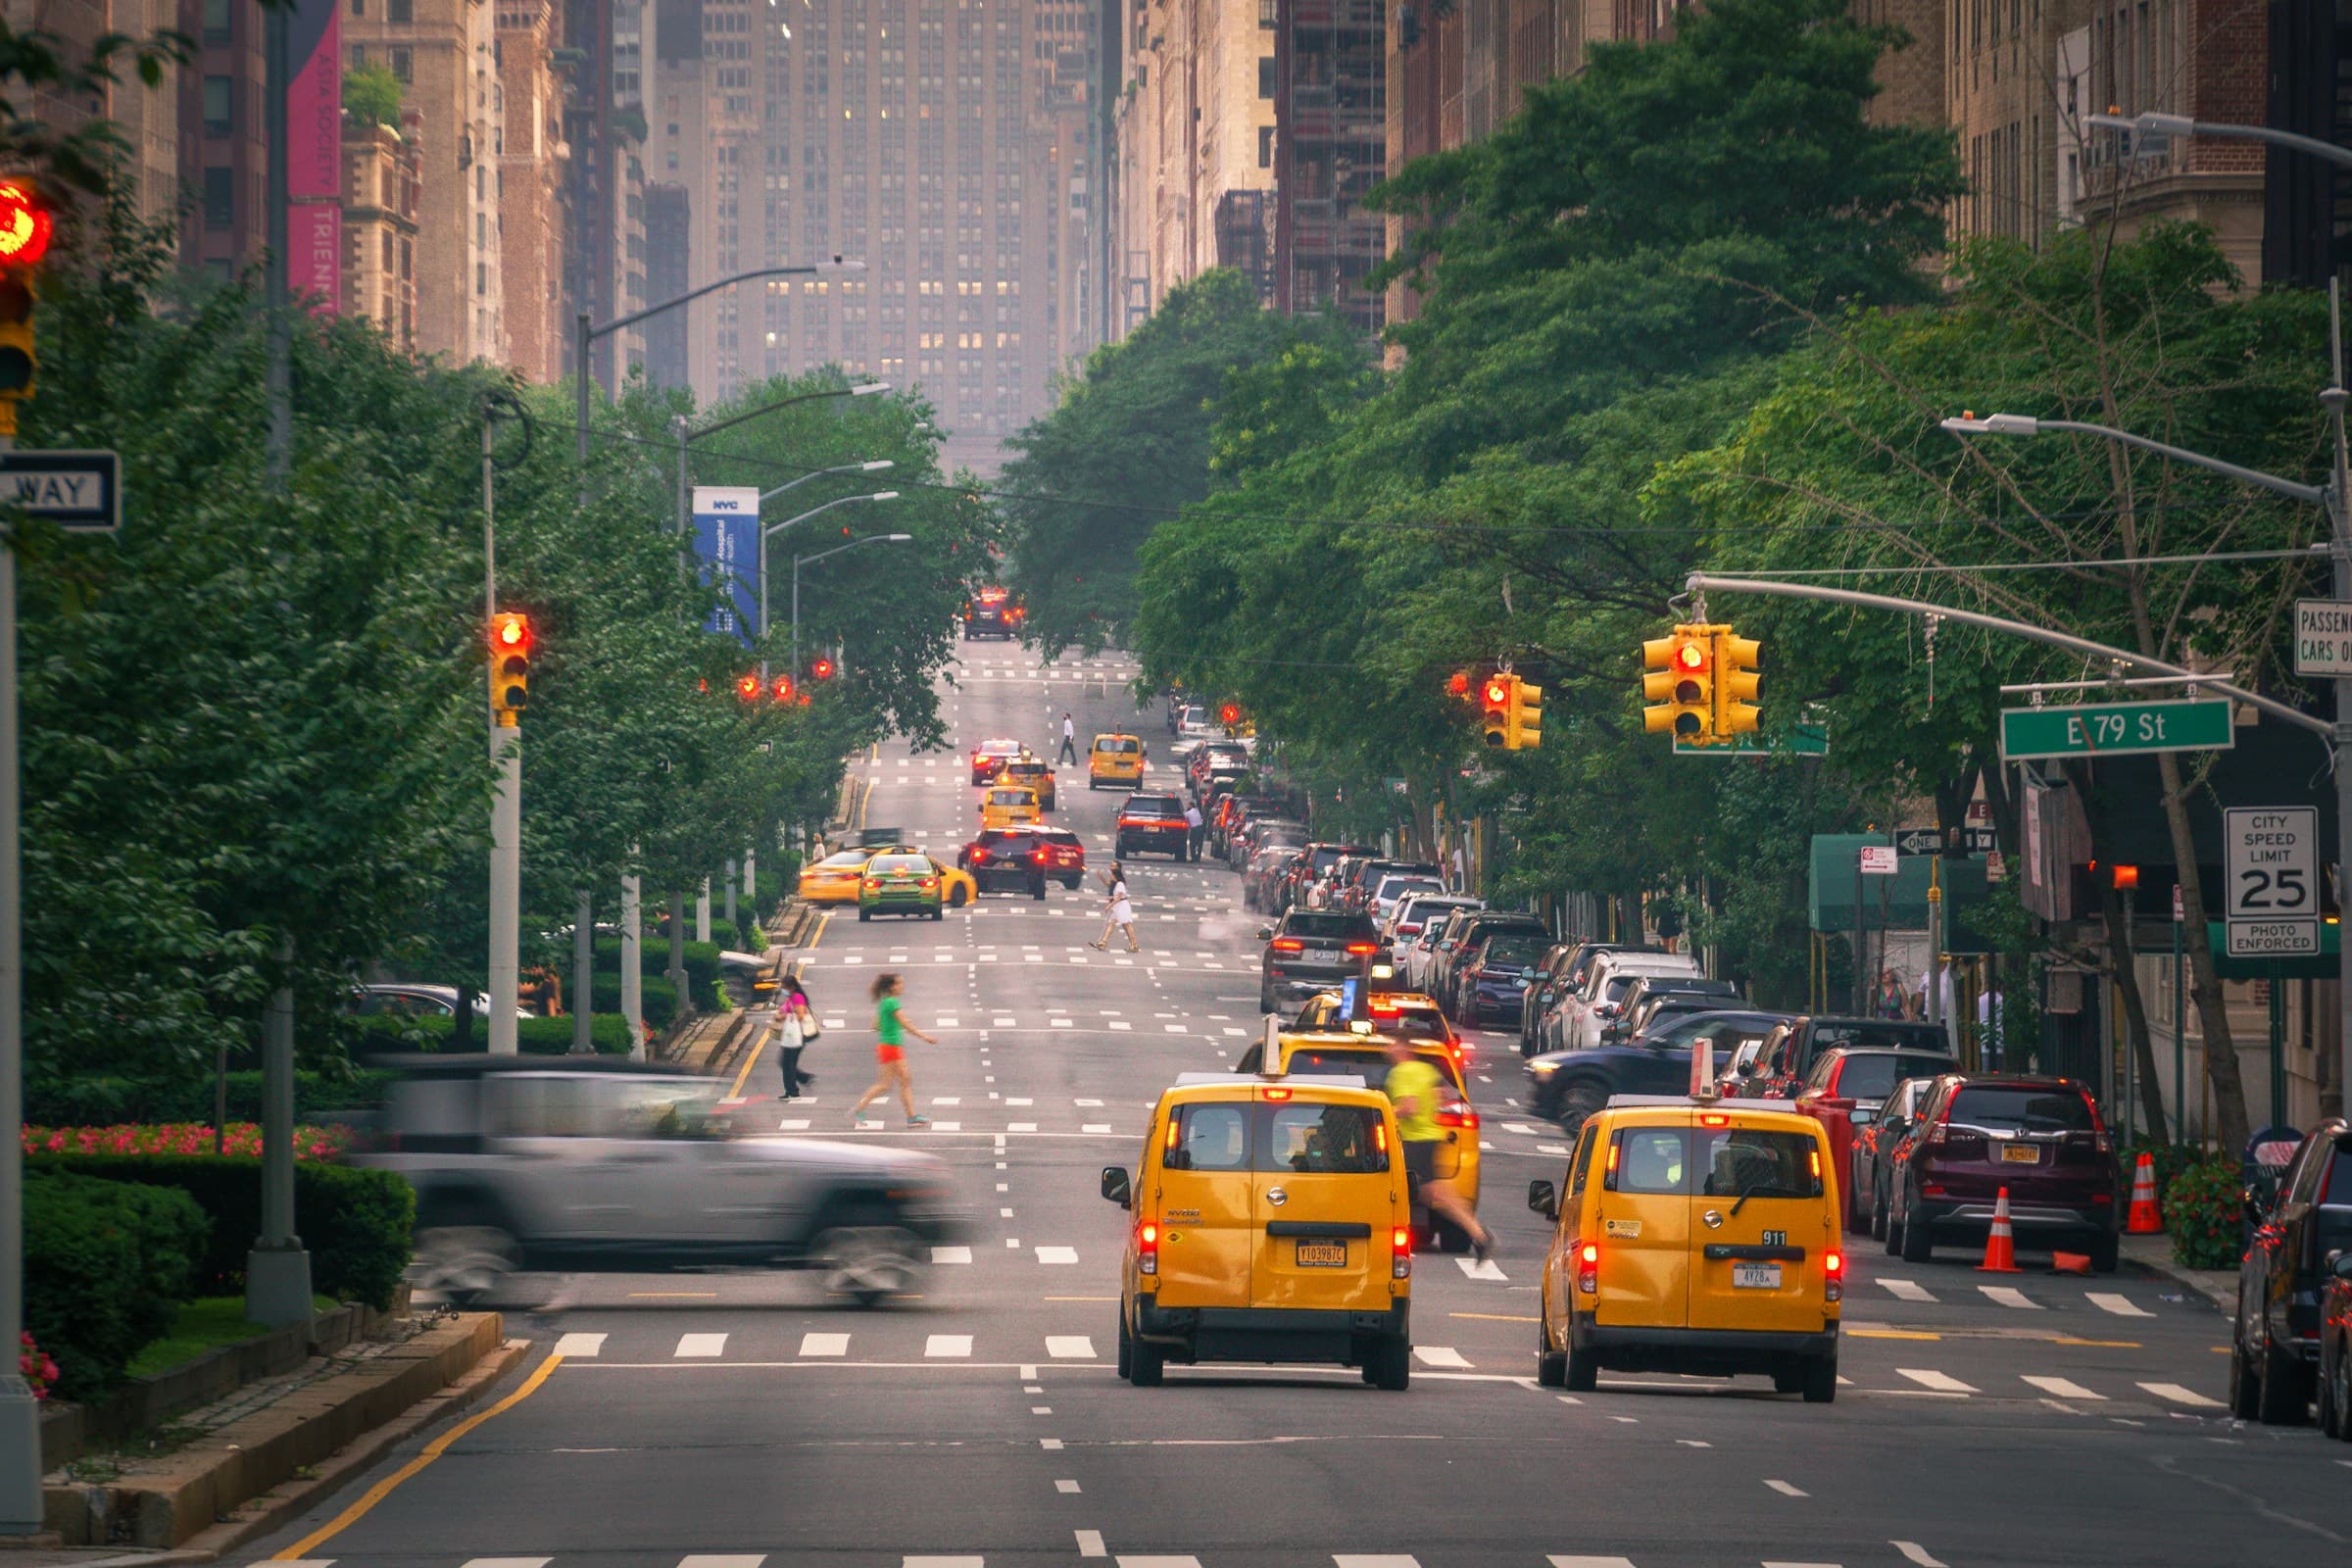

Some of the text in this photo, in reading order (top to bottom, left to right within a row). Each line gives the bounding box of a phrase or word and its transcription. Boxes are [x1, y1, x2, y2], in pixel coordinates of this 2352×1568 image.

[318, 54, 333, 187] ASIA SOCIETY
[15, 475, 86, 505] WAY
[713, 501, 738, 510] NYC
[2301, 611, 2352, 632] PASSEN
[2301, 639, 2352, 662] CARS O
[2068, 712, 2166, 745] E 79 St
[2252, 815, 2287, 828] CITY
[1908, 837, 1933, 849] ONE
[2244, 833, 2296, 846] SPEED
[2250, 850, 2291, 862] LIMIT
[2240, 869, 2307, 907] 25
[2250, 925, 2296, 937] PHOTO
[2236, 938, 2310, 950] ENFORCED
[1764, 1231, 1786, 1246] 911
[1301, 1247, 1342, 1260] Y103987C
